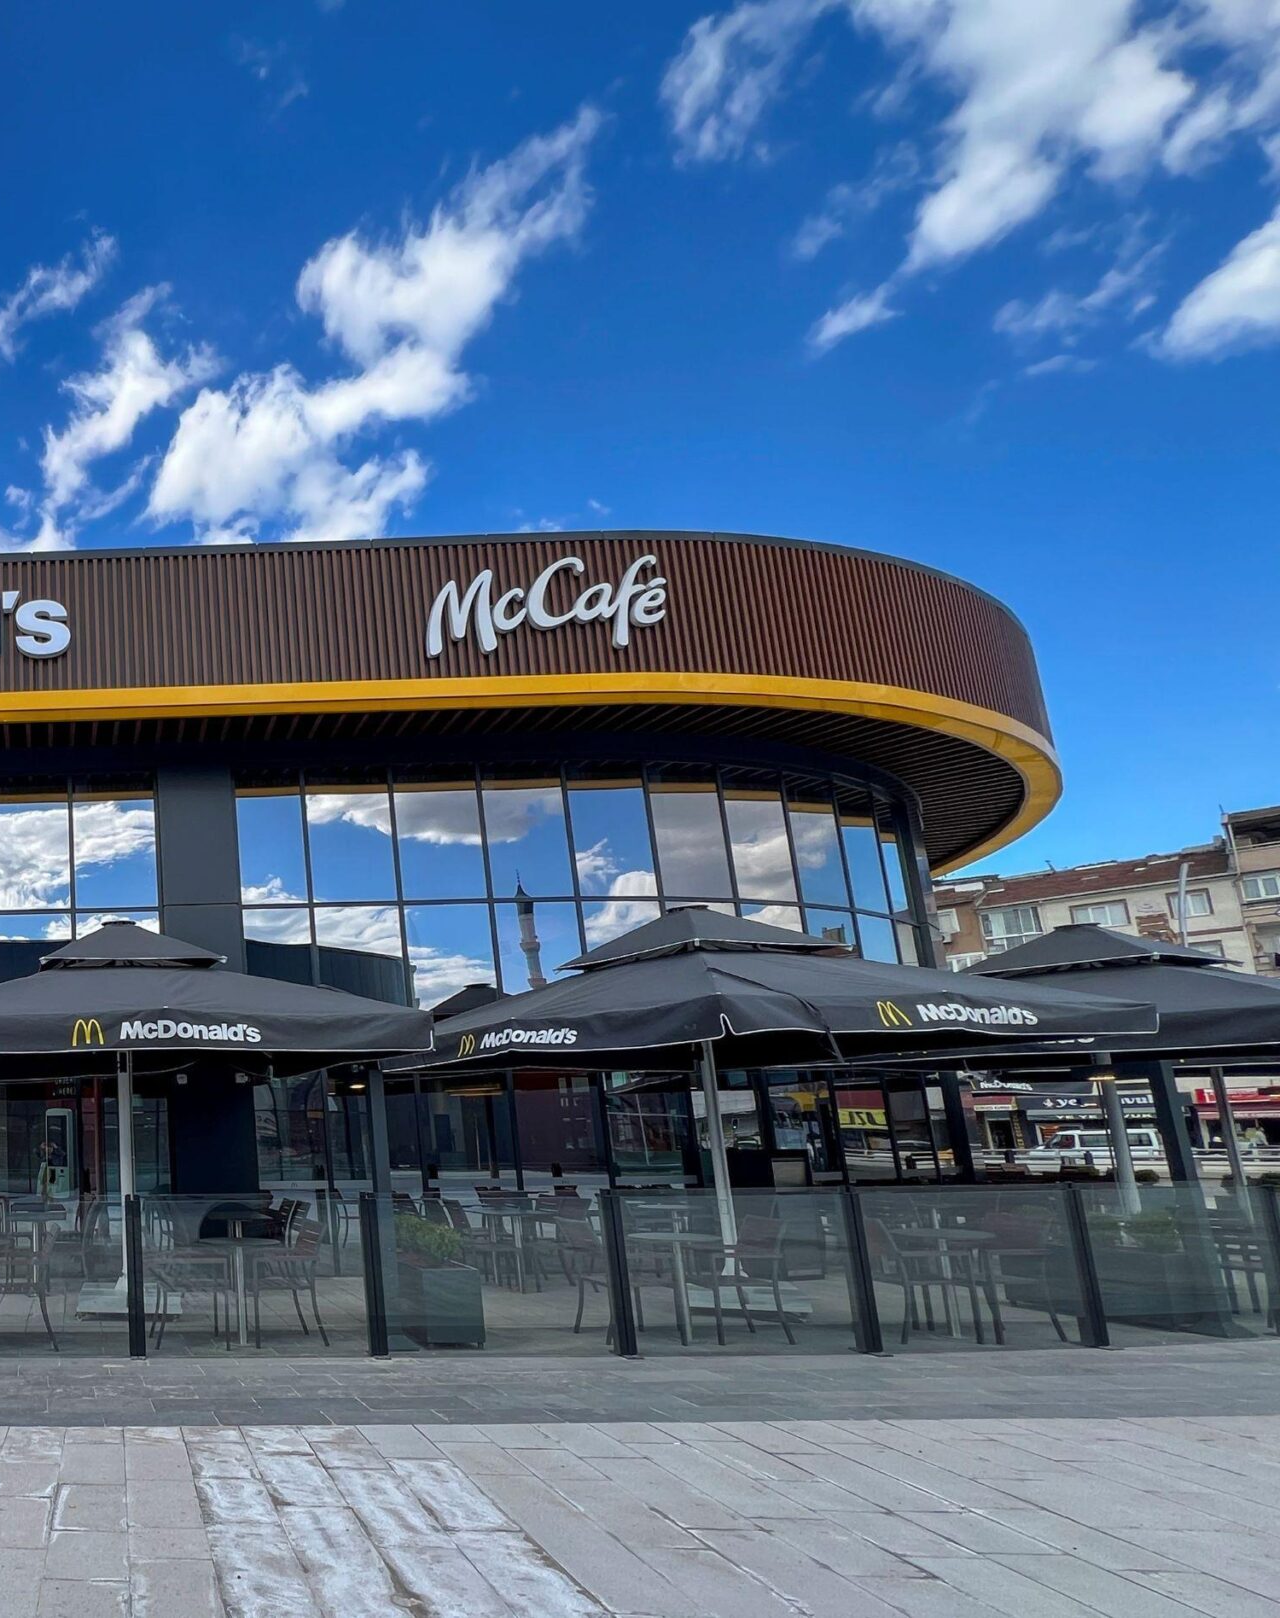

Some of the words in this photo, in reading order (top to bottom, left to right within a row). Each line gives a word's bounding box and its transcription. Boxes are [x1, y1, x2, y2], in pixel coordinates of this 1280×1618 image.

[426, 554, 668, 659] McCafé
[916, 1003, 1038, 1026] McDonald's
[120, 1019, 262, 1043] McDonald's
[480, 1028, 578, 1049] McDonald's
